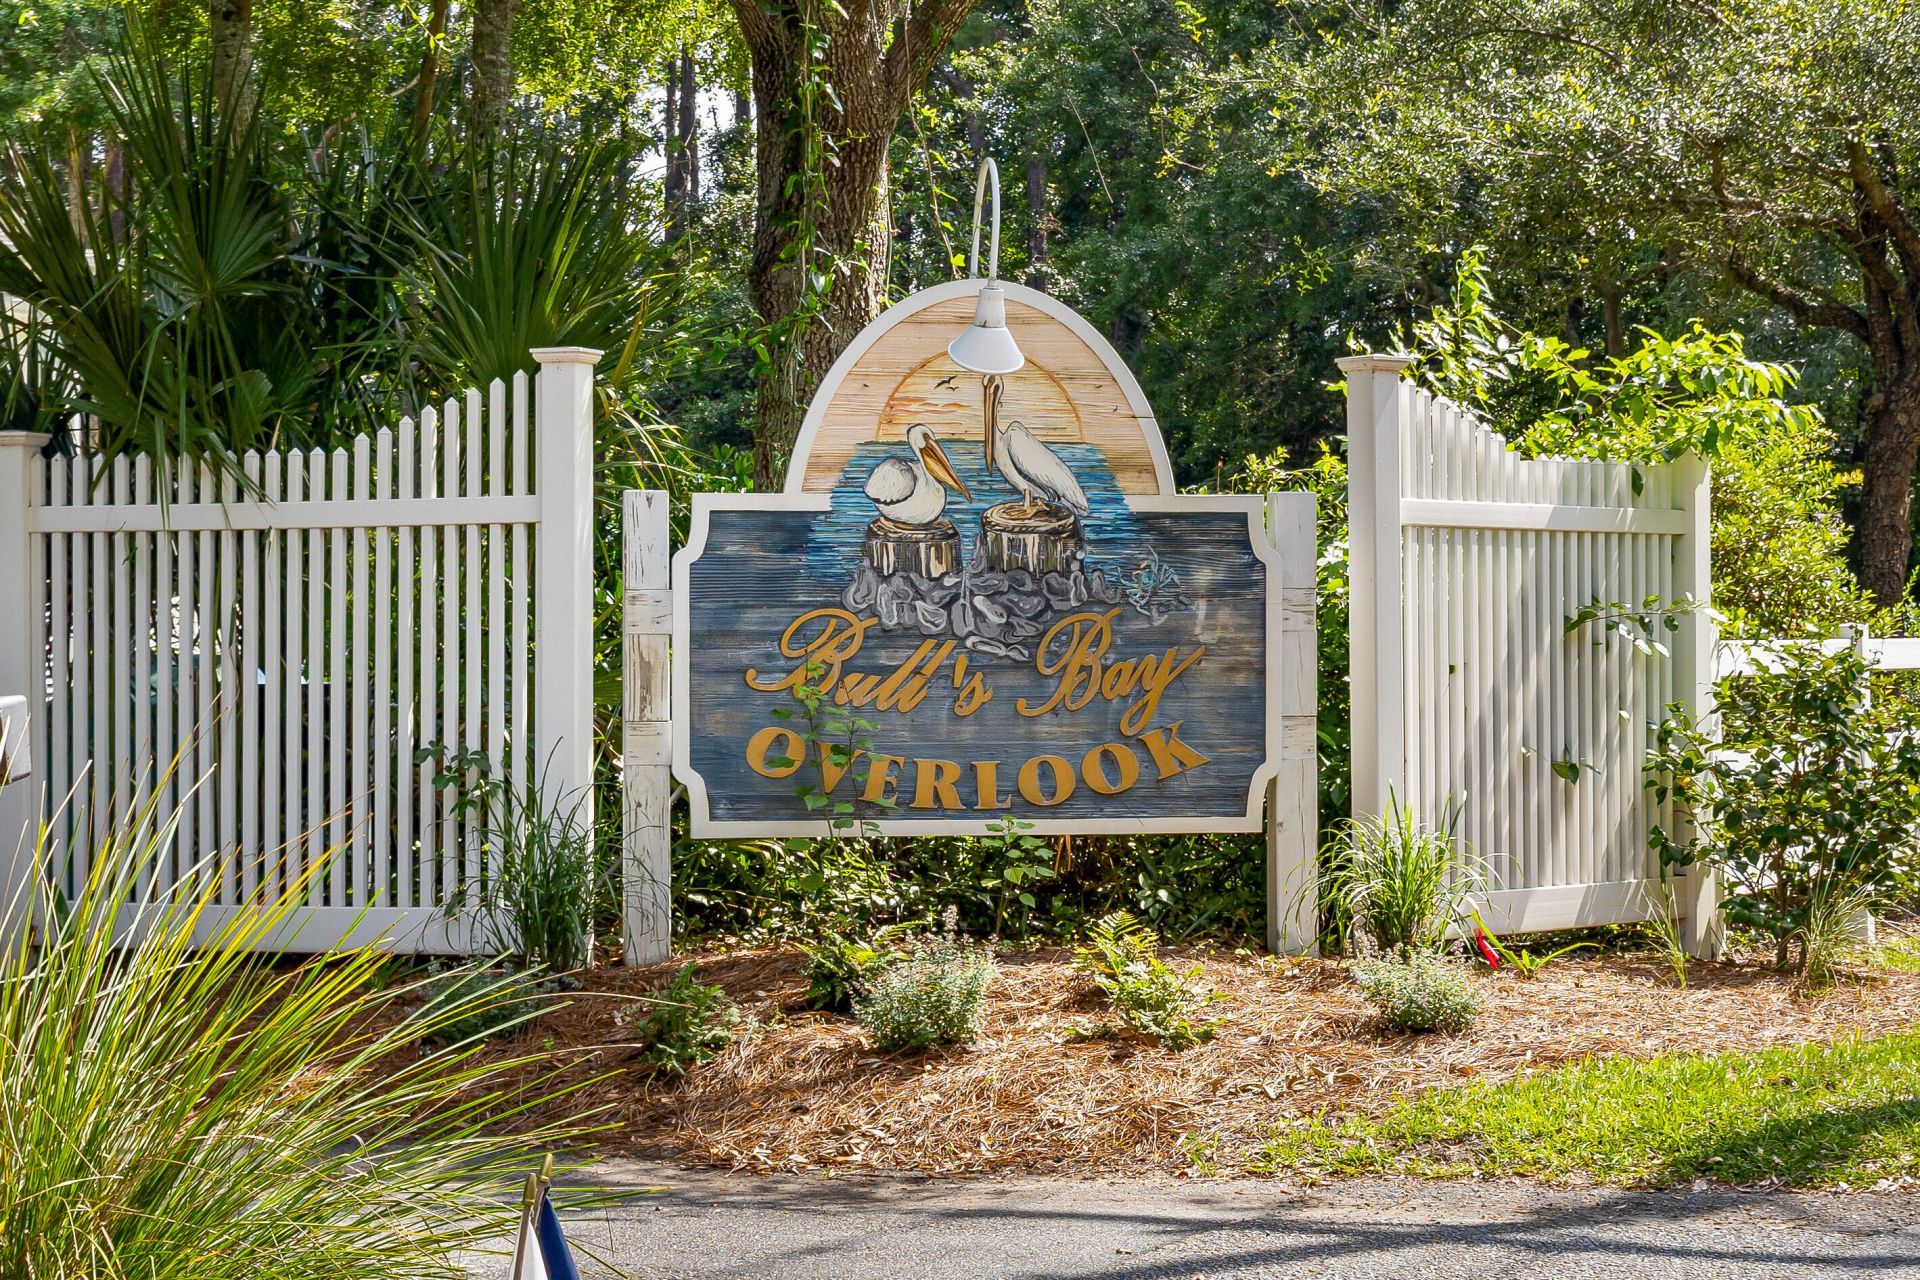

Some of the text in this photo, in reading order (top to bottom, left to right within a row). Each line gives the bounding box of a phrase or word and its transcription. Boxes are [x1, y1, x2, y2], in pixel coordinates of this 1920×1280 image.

[745, 607, 1206, 736] Bull's Bay
[745, 721, 1211, 809] OVERLOOK
